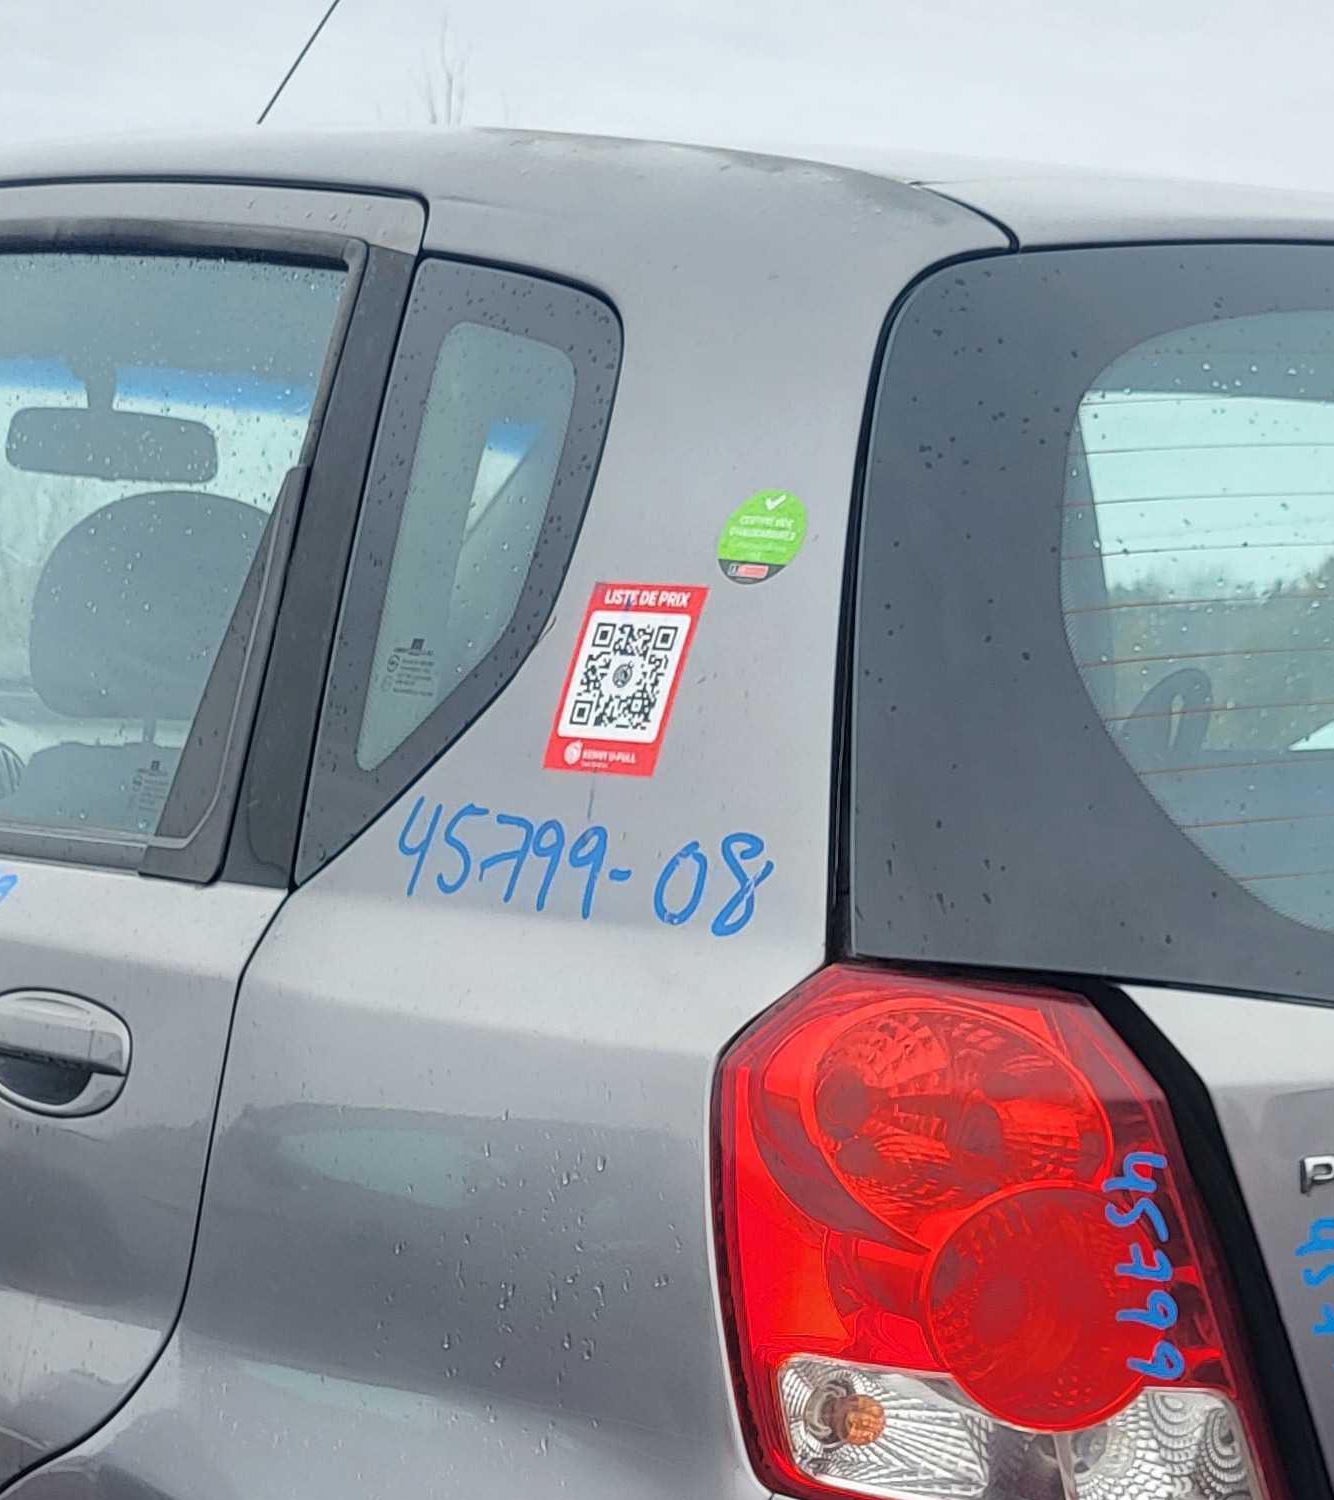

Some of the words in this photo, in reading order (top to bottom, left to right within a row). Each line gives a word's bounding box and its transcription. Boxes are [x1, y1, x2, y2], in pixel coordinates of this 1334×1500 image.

[603, 588, 638, 606] LISTE
[638, 590, 657, 607] DE
[657, 591, 691, 609] PRIX
[398, 797, 775, 938] 45799-08
[1104, 1153, 1184, 1379] 45799
